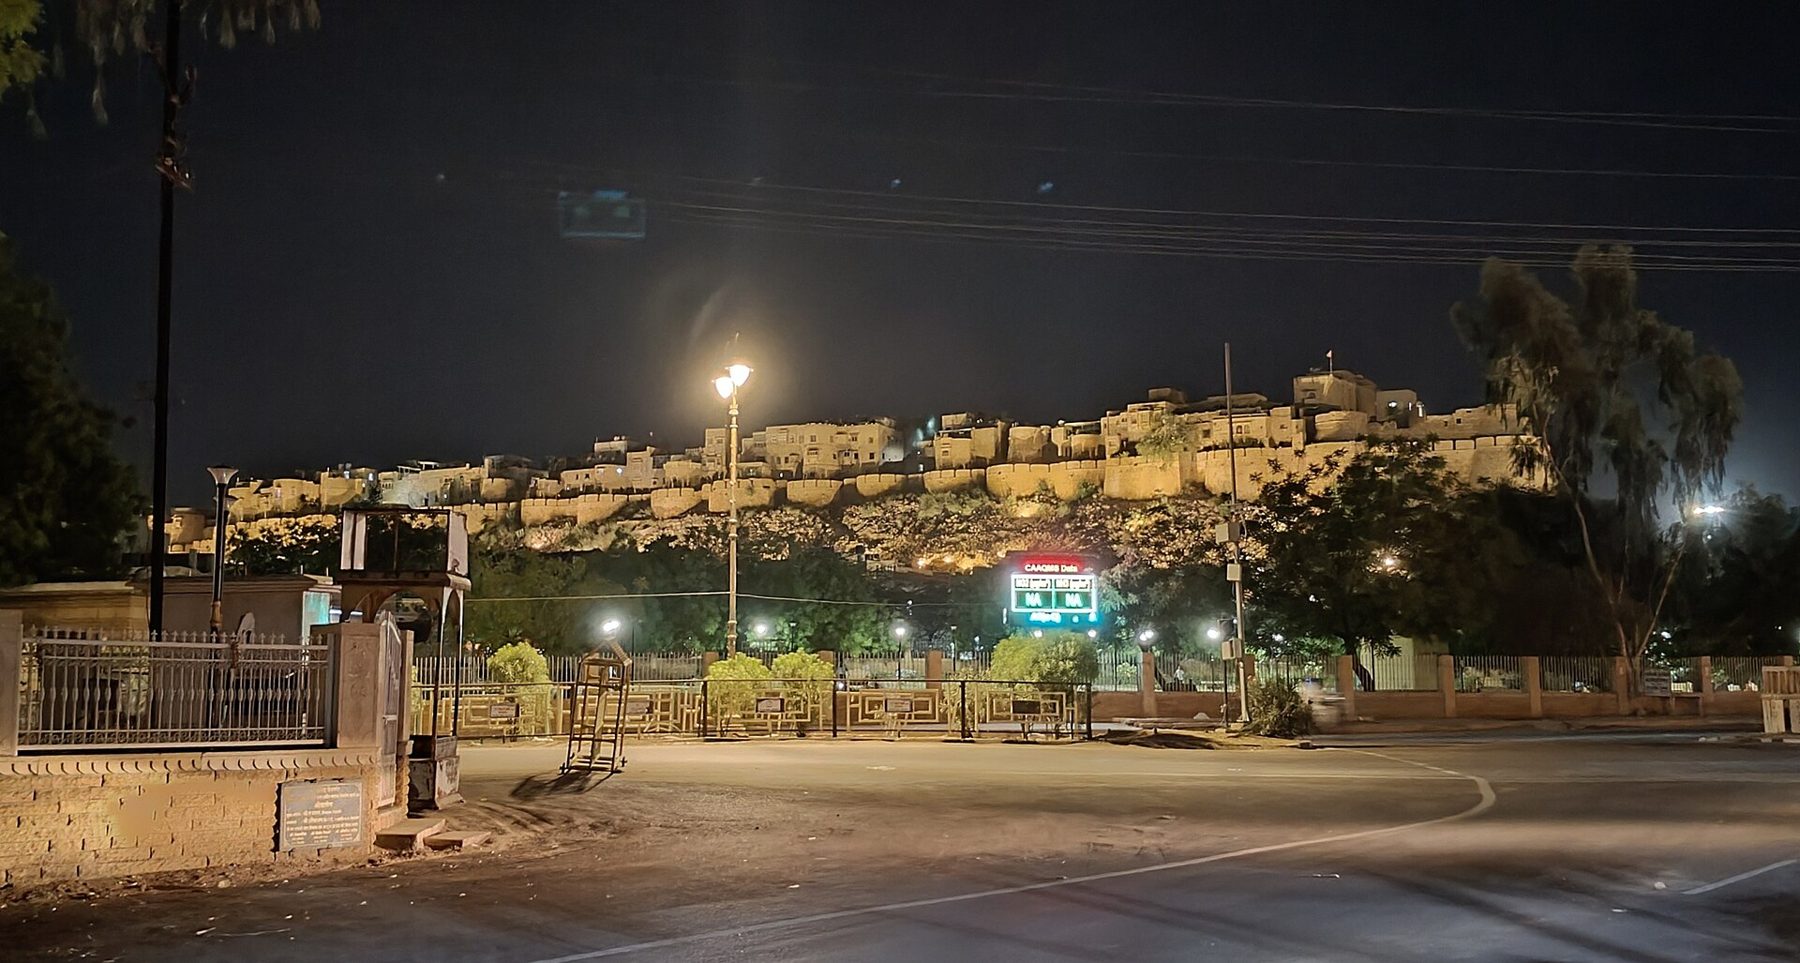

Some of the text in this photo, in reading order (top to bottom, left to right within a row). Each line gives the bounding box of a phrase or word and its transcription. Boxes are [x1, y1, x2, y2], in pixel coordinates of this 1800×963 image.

[1061, 564, 1078, 572] Data
[1025, 592, 1042, 607] NA
[1065, 592, 1083, 607] NA
